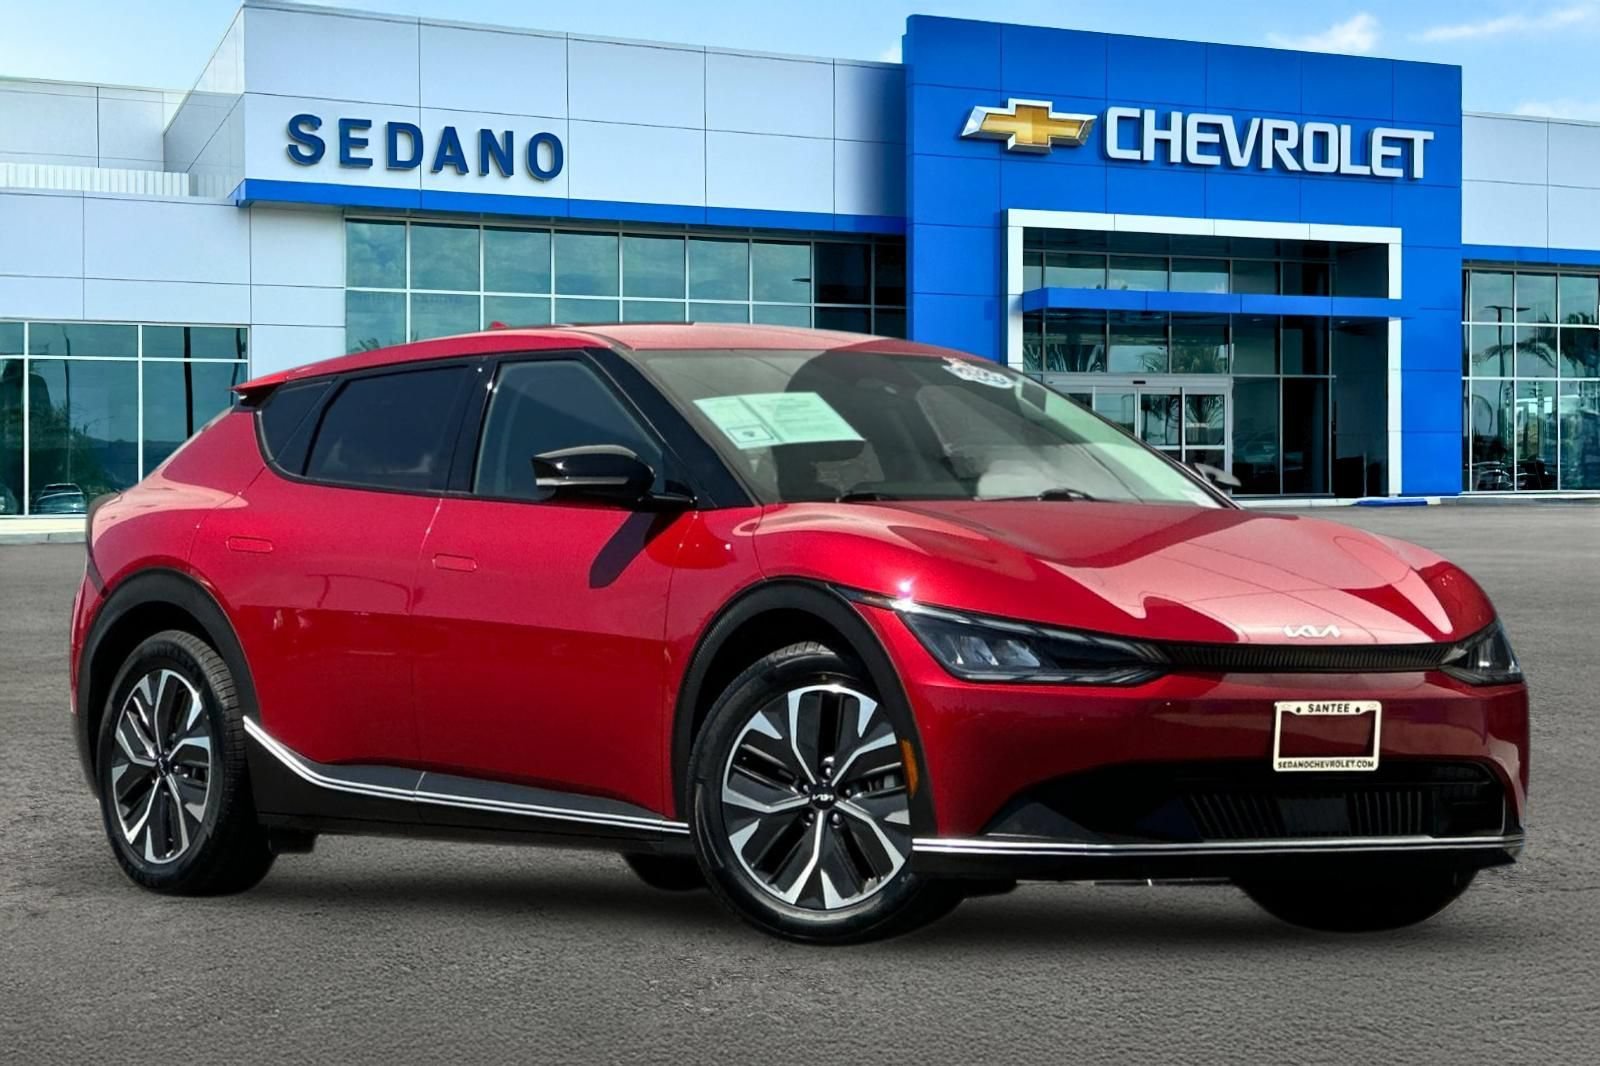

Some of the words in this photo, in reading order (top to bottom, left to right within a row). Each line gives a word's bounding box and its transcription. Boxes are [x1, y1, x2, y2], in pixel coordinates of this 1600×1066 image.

[282, 114, 564, 181] SEDANO
[1106, 106, 1434, 179] CHEVROLET
[1308, 703, 1350, 712] SANTEE
[1278, 760, 1374, 769] SEDANOCHEVROLET.COM
